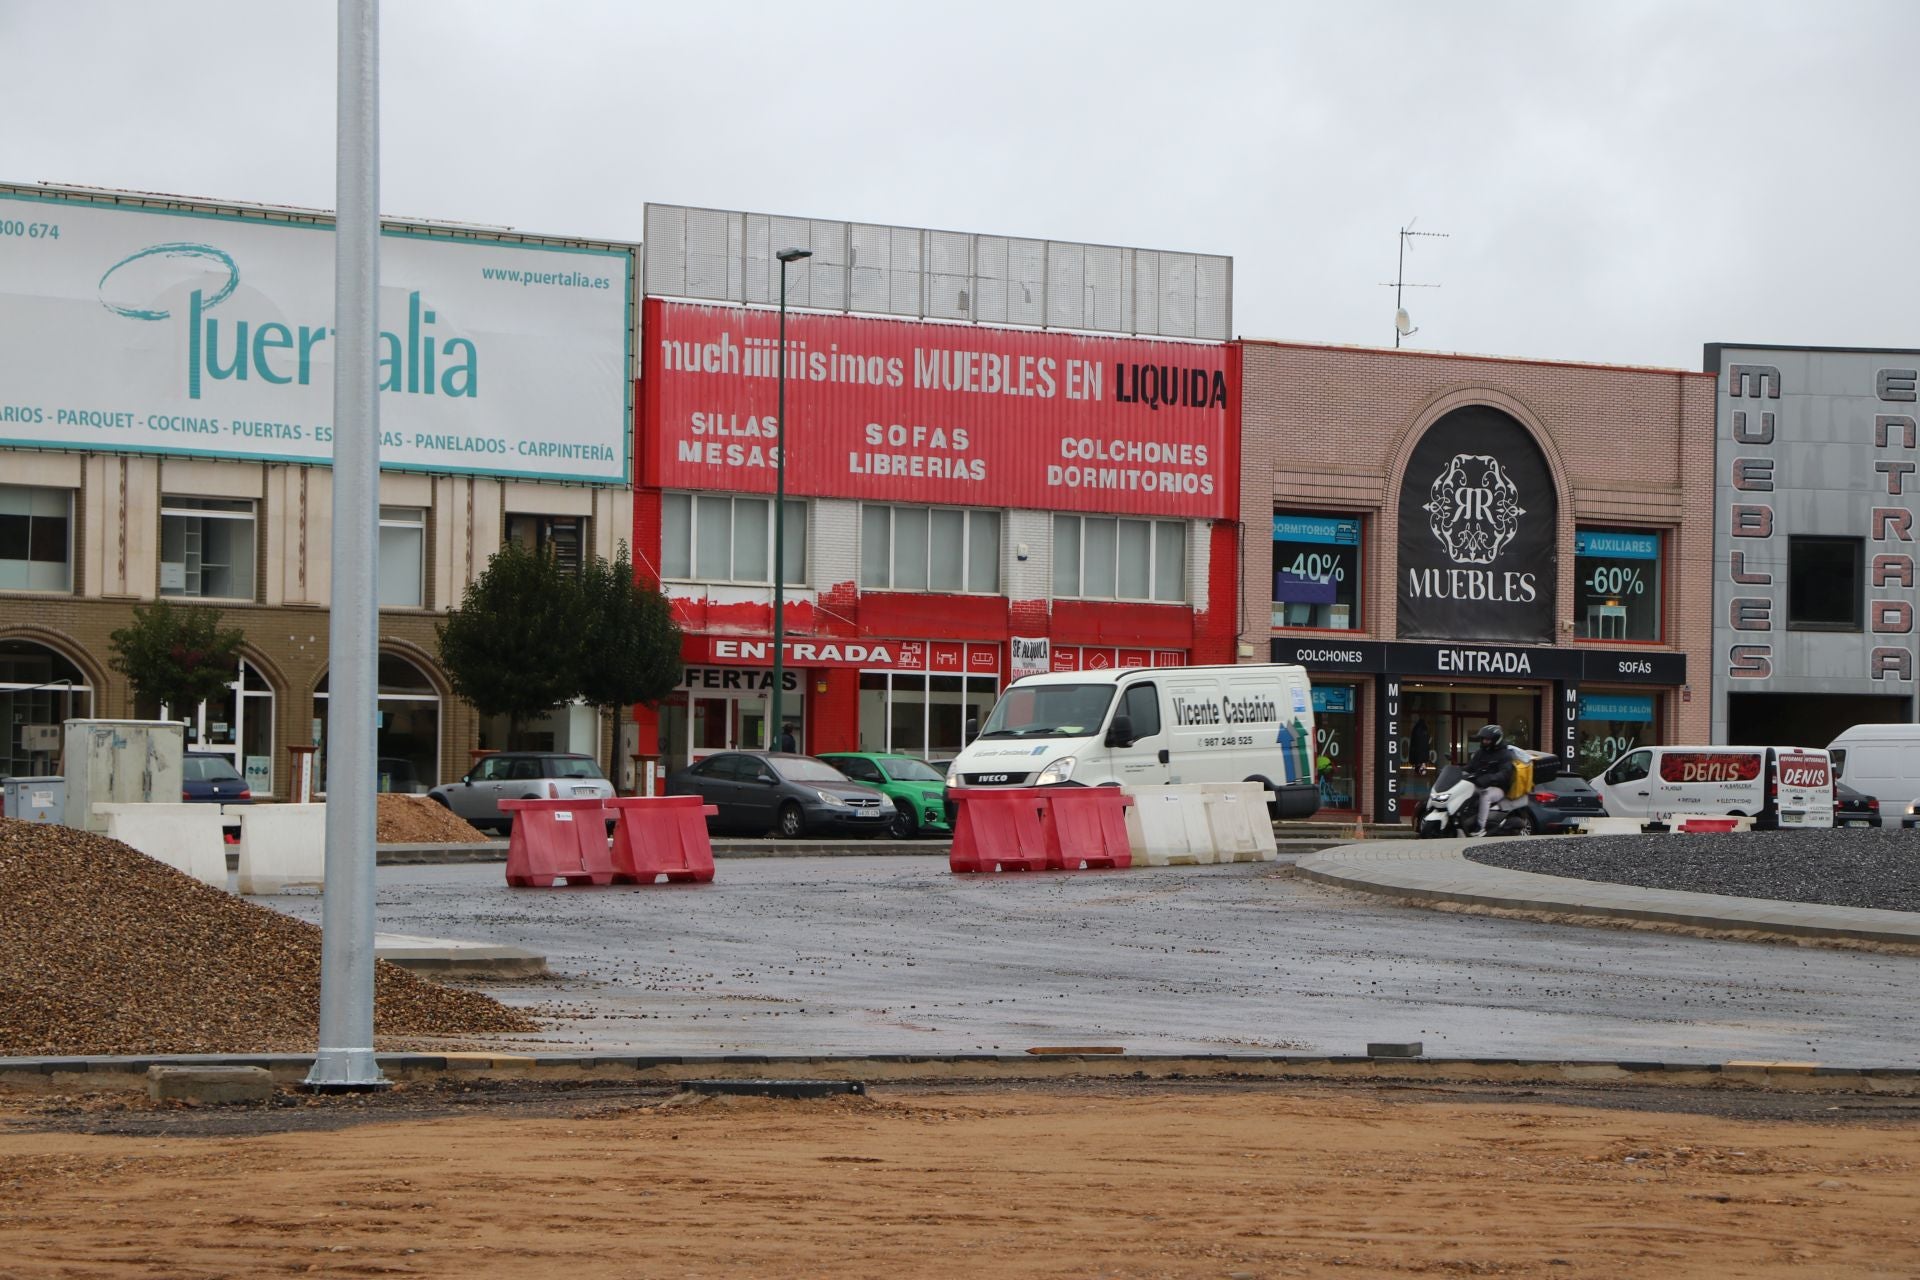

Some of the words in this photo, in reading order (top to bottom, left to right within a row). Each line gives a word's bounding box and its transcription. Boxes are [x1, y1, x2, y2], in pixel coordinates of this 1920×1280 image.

[29, 222, 60, 239] 674
[482, 268, 610, 289] www.puertalia.es
[914, 347, 1056, 398] MUEBLES
[1066, 358, 1102, 401] EN
[1116, 363, 1227, 410] LIQUIDA
[57, 409, 134, 428] PARQUET
[147, 415, 219, 434] COCINAS
[232, 421, 301, 440] PUERTAS
[415, 434, 506, 454] PANELADOS
[518, 441, 614, 461] CARPINTERÍA
[691, 411, 778, 438] SILLAS
[865, 423, 969, 451] SOFAS
[678, 439, 786, 469] MESAS
[1061, 437, 1208, 466] COLCHONES
[849, 452, 986, 480] LIBRERIAS
[1047, 464, 1213, 495] DORMITORIOS
[1728, 363, 1781, 680] MUEBLES
[1869, 368, 1918, 681] ENTRADA
[1590, 538, 1652, 553] AUXILIARES
[1282, 553, 1344, 582] -40%
[1585, 566, 1644, 594] -60%
[1409, 568, 1536, 602] MUEBLES
[716, 640, 892, 663] ENTRADA
[1012, 640, 1021, 658] SE
[1022, 641, 1048, 661] ALQUILA
[1297, 649, 1363, 664] COLCHONES
[1438, 650, 1532, 675] ENTRADA
[678, 668, 797, 691] FERTAS
[1618, 660, 1652, 675] SOFÁS
[1172, 696, 1220, 726] Vicente
[1223, 694, 1277, 724] Castañón
[1586, 702, 1617, 713] MUEBLES
[1619, 704, 1627, 713] DE
[1204, 737, 1219, 747] 987
[1221, 737, 1236, 746] 248
[1238, 736, 1253, 745] 525
[1388, 683, 1399, 812] MUEBLES
[979, 774, 1008, 783] IVECO
[1683, 762, 1740, 782] DENIS
[1783, 768, 1825, 786] DENIS
